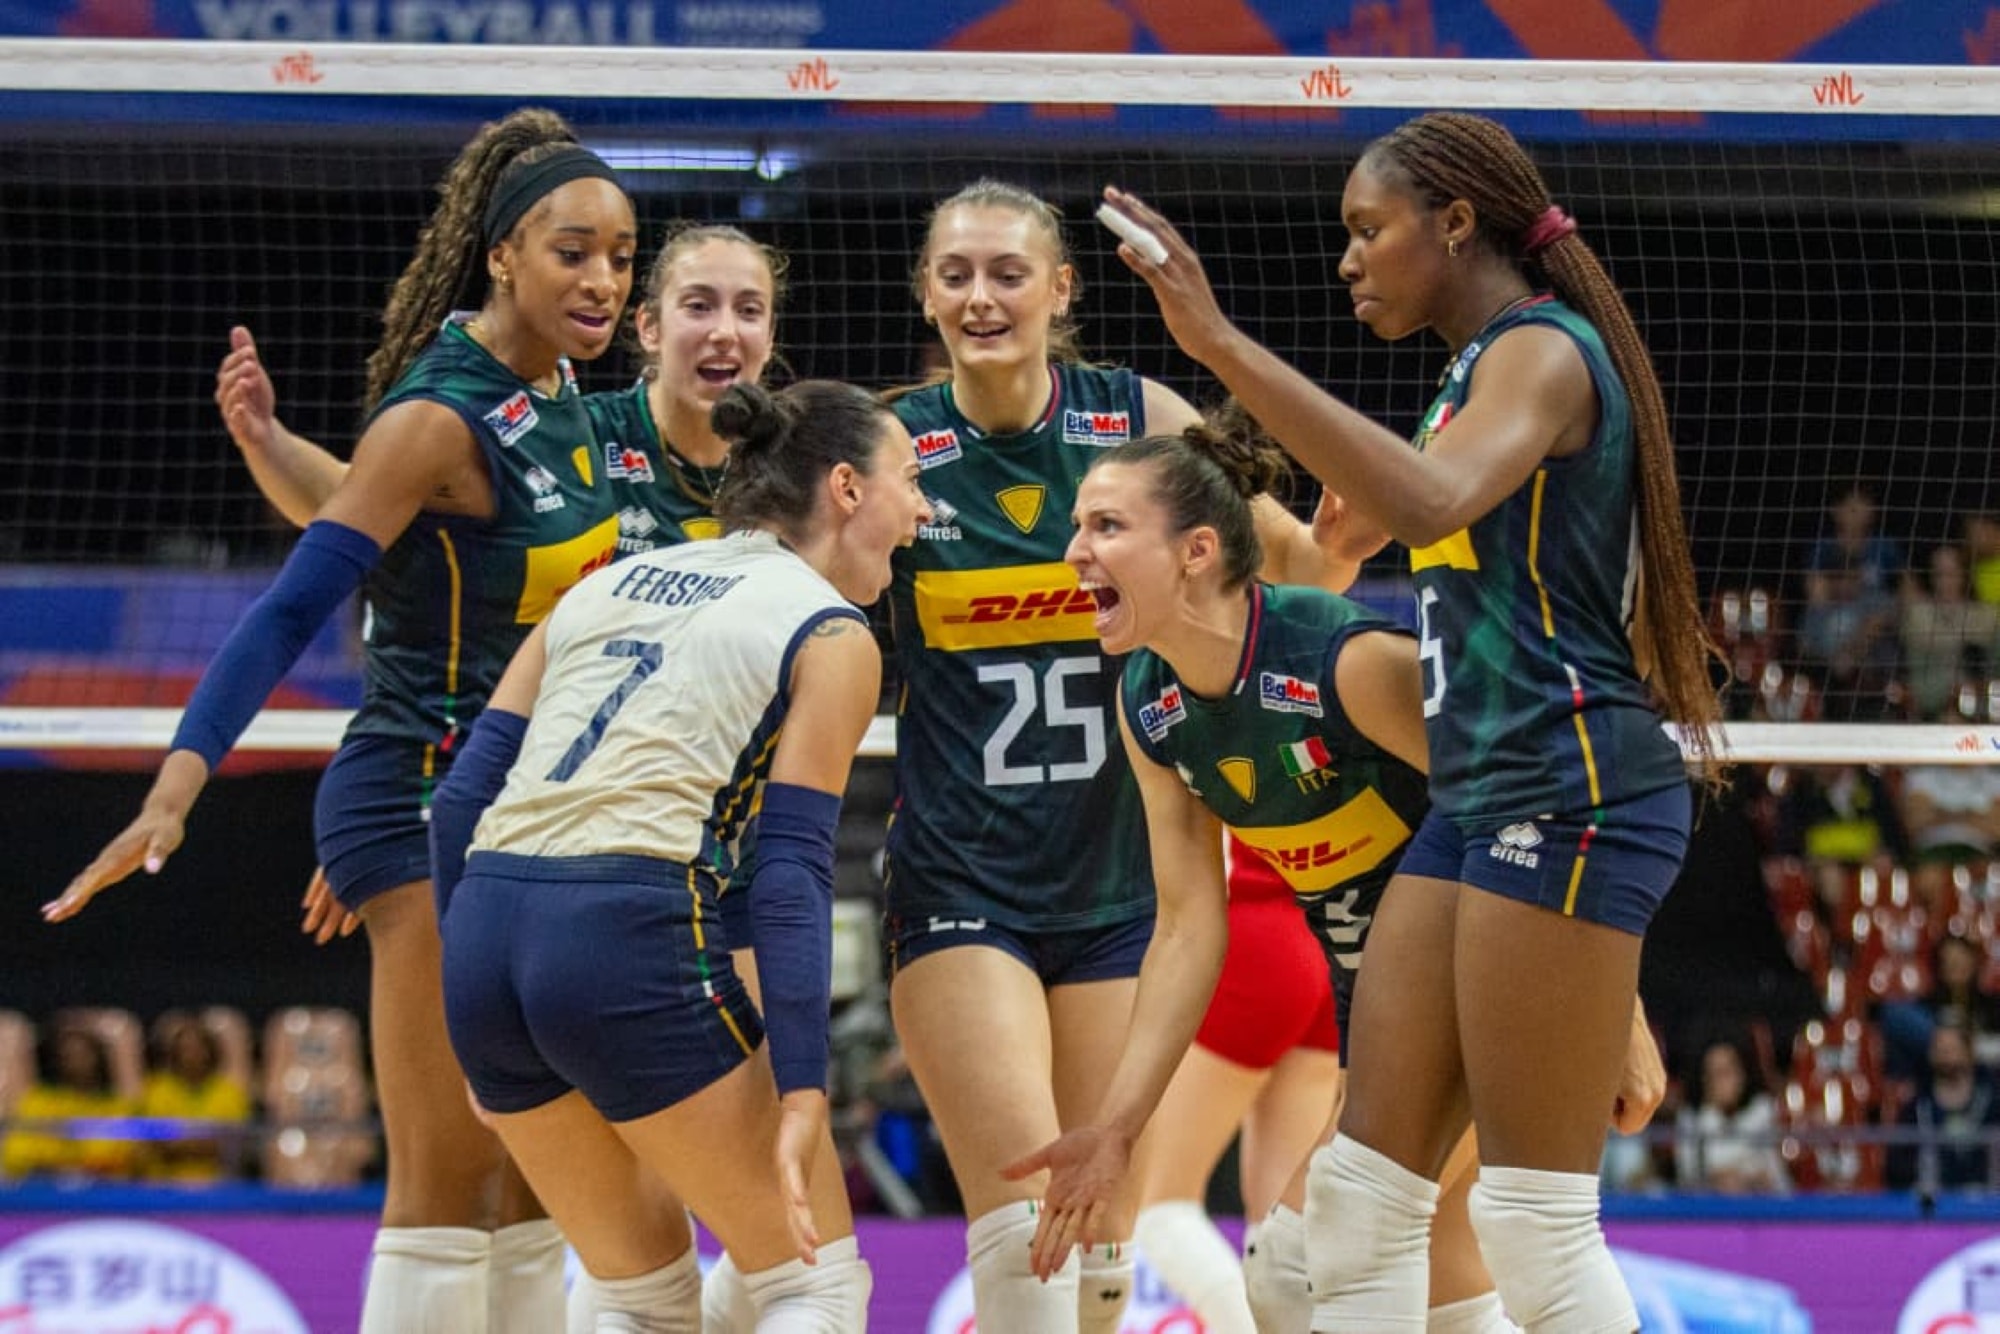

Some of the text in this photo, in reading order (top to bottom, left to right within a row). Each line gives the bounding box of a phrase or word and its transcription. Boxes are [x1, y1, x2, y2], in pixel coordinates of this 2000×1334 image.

[197, 0, 657, 46] VOLLEYBALL
[916, 432, 956, 456] Mat
[968, 587, 1099, 624] DHL
[545, 639, 664, 782] 7
[977, 656, 1107, 786] 25
[1296, 768, 1339, 796] ITA
